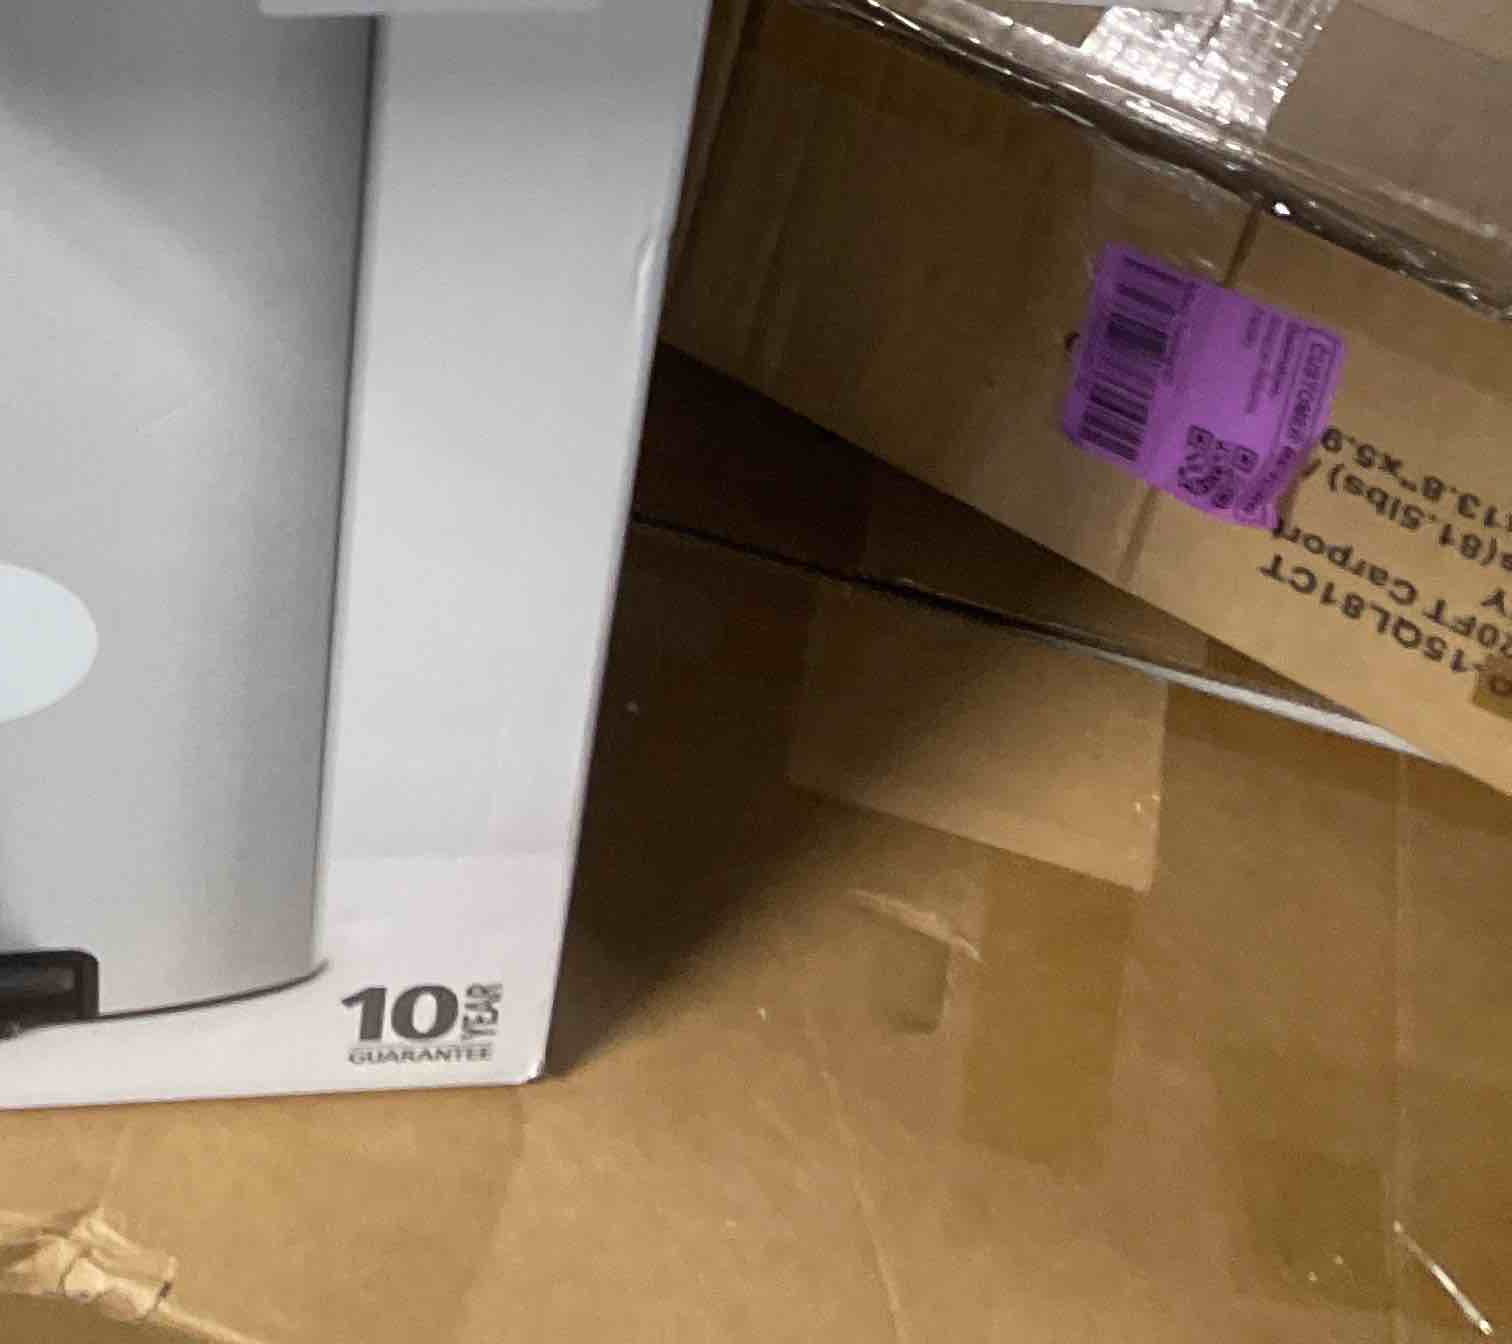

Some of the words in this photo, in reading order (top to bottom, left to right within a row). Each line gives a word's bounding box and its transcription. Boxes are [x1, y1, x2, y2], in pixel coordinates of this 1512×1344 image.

[1272, 518, 1418, 607] Carport
[341, 984, 460, 1041] 10
[460, 983, 503, 1041] YEAR
[348, 1042, 494, 1065] GUARANTEE
